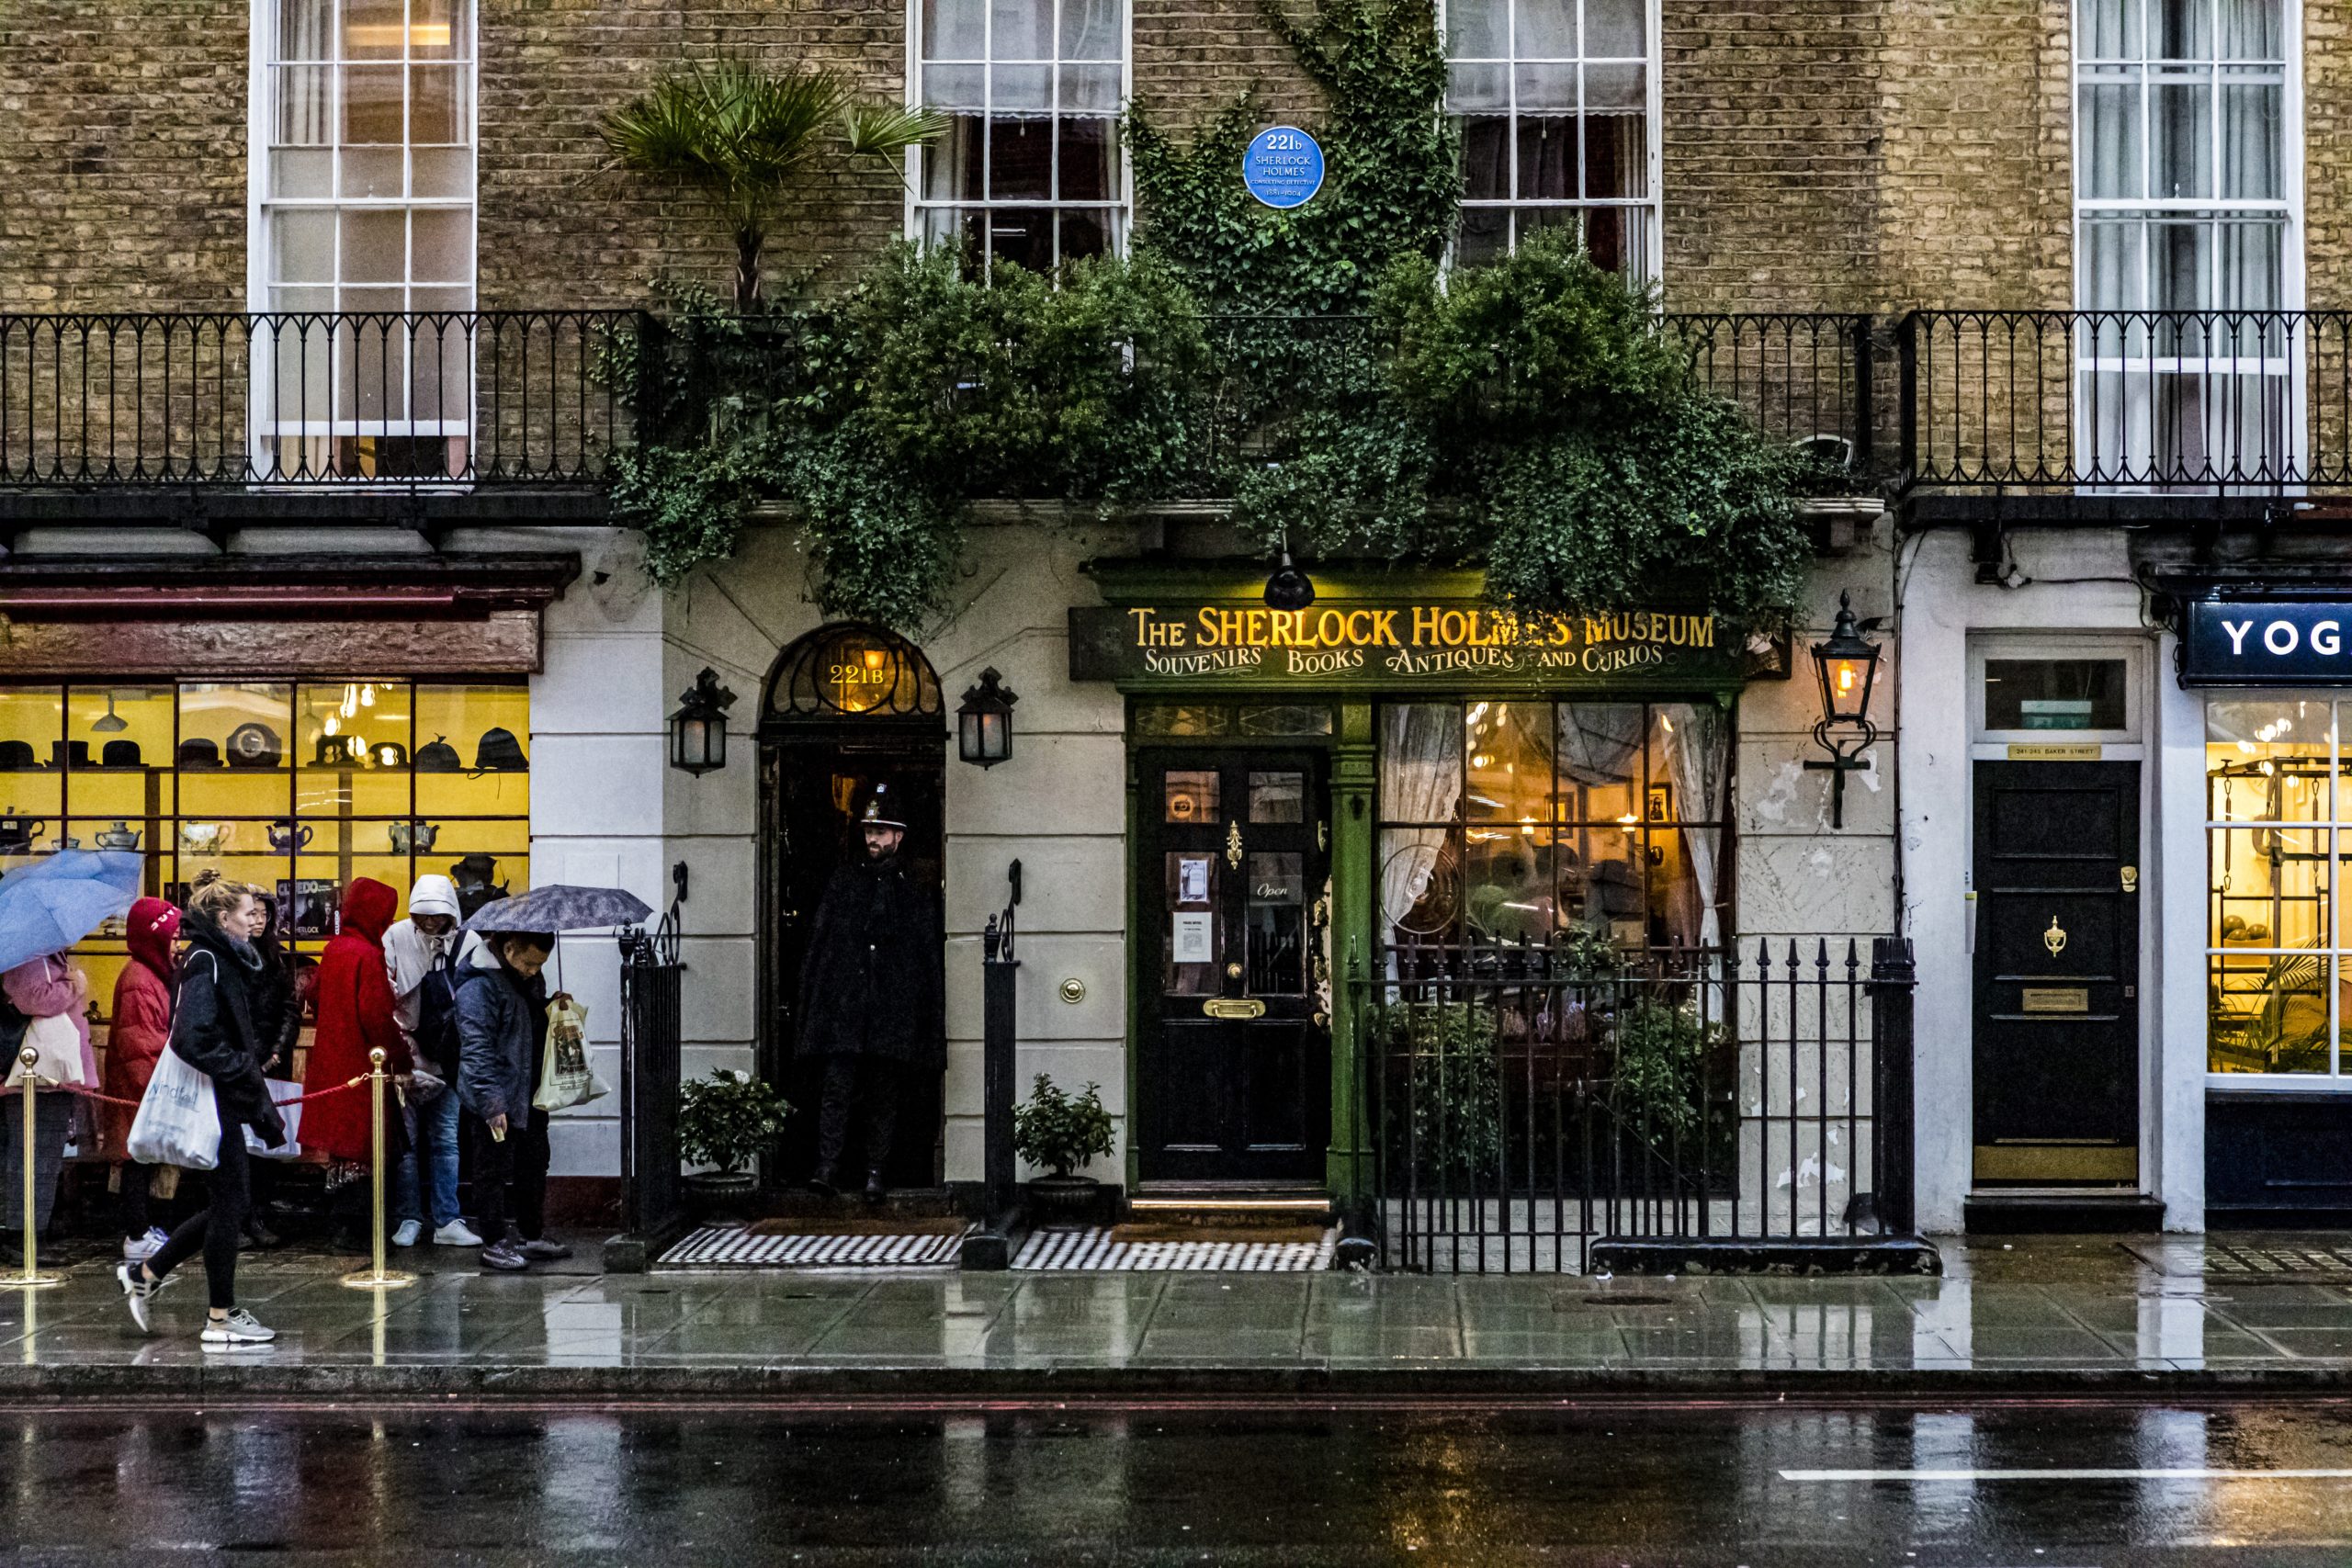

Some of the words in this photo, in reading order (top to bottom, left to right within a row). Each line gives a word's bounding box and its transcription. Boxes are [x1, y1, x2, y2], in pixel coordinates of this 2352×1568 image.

[1266, 134, 1303, 150] 221b
[1255, 156, 1311, 166] SHERLOCK
[1262, 167, 1306, 176] HOLMES
[1196, 606, 1400, 648] SHERLOCK
[1537, 652, 1577, 668] AND
